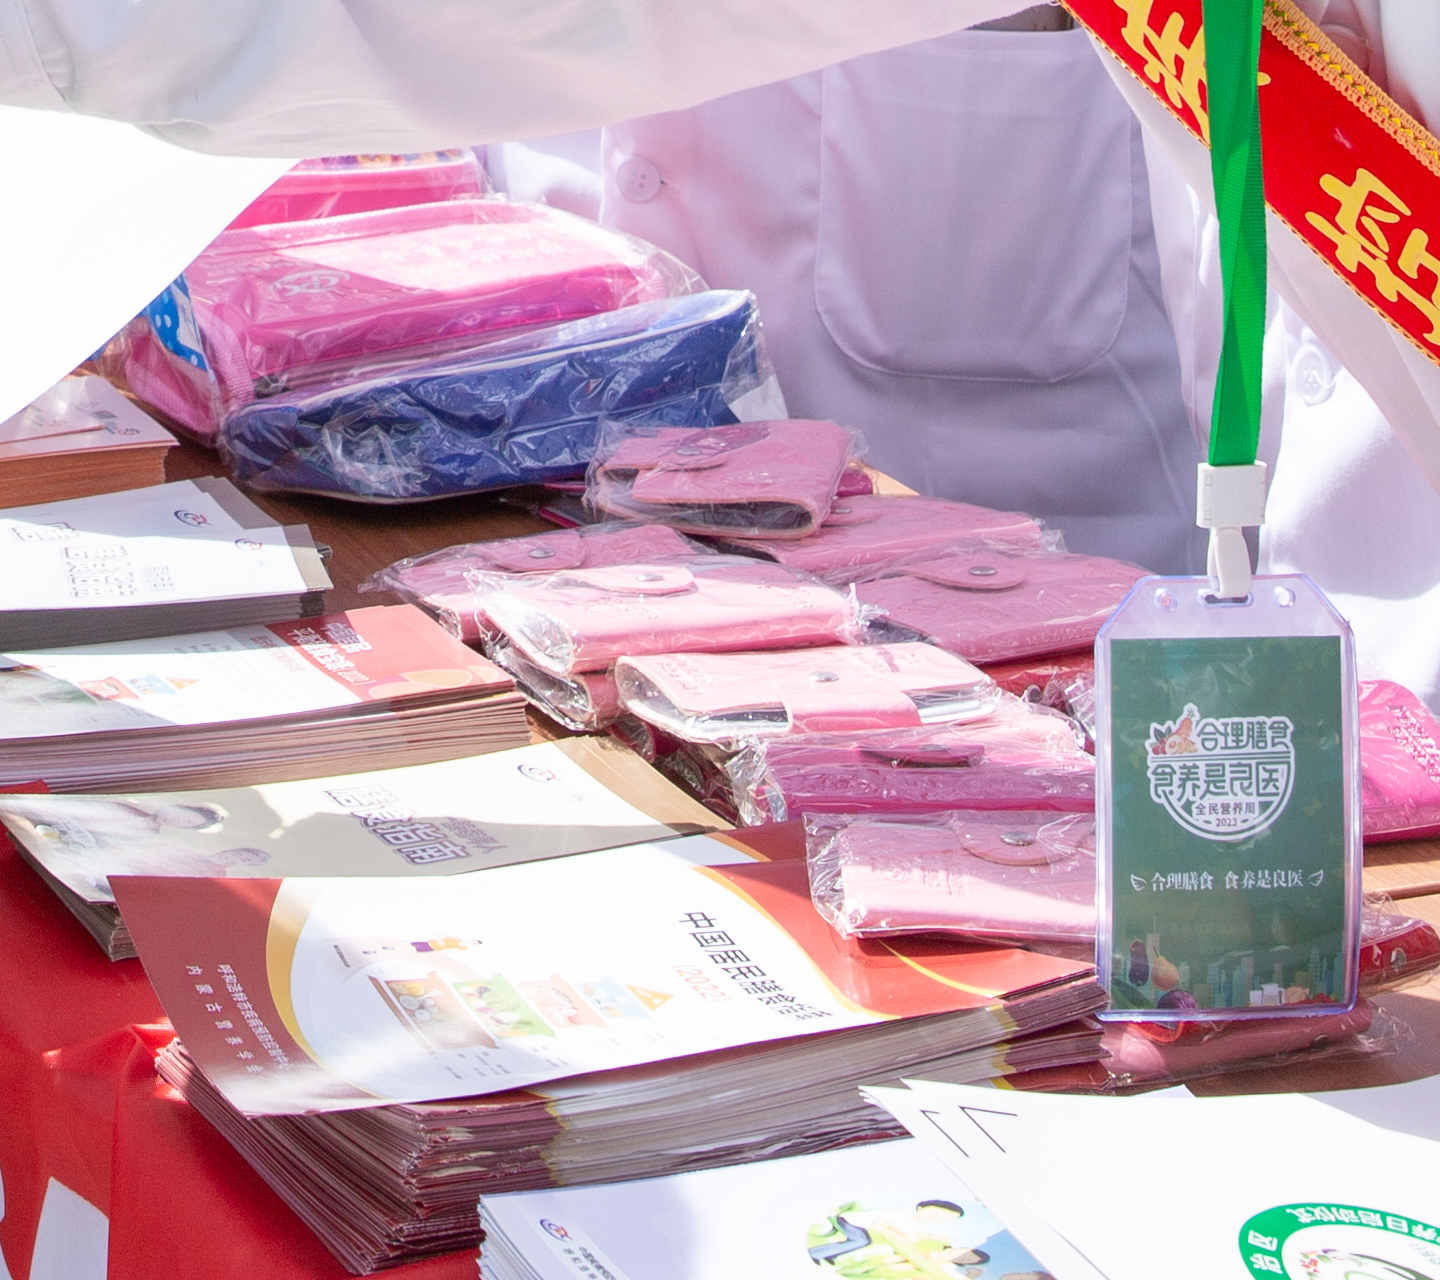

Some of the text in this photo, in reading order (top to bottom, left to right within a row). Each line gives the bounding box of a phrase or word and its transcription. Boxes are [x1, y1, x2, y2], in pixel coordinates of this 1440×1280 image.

[1198, 719, 1291, 751] 合理膳食
[1150, 762, 1284, 802] 食养是良医
[1195, 801, 1258, 816] 全民营养周
[1215, 817, 1238, 828] 2023
[1150, 868, 1304, 892] 合理膳食 食养是良医
[678, 911, 833, 1022] 中国居民膳食指南
